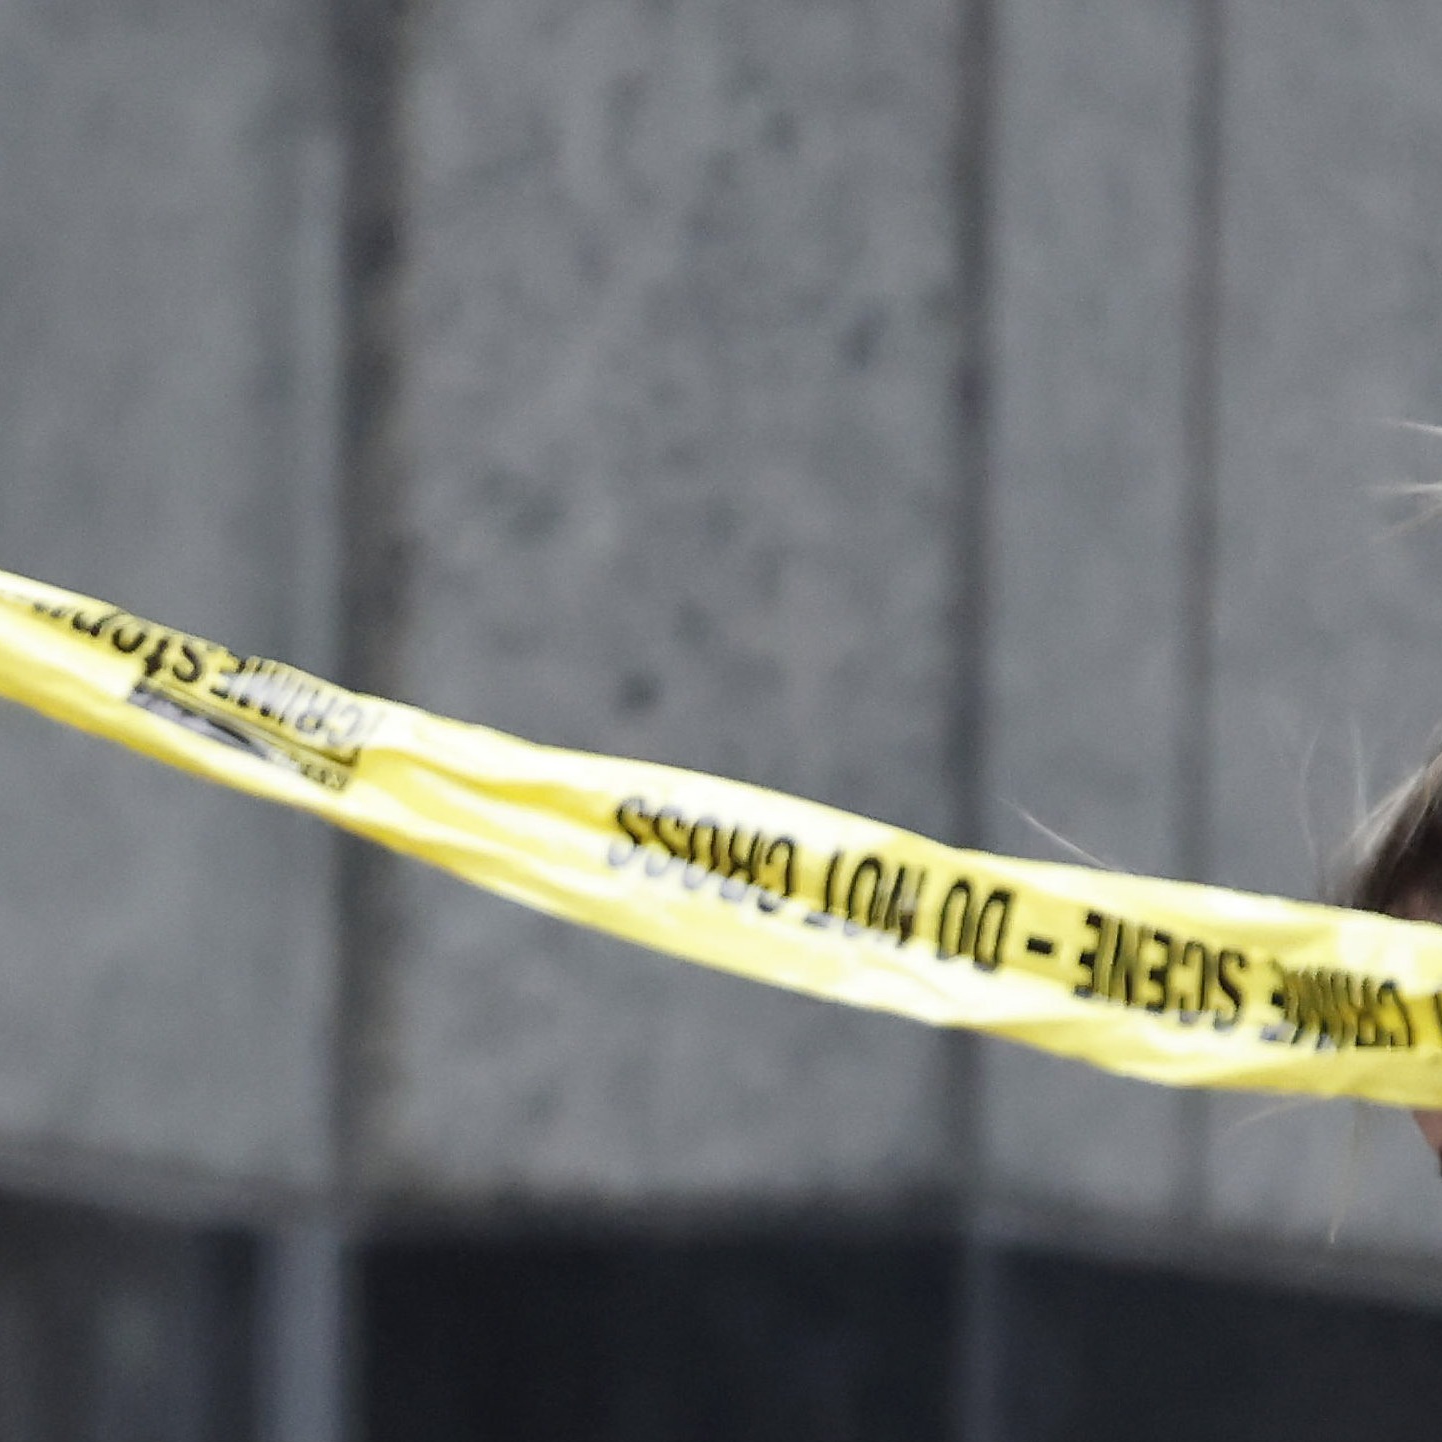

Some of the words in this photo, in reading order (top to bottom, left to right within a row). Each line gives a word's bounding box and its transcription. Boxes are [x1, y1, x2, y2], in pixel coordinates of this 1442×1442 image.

[608, 797, 797, 914] CROSS
[804, 849, 927, 948] NOT
[936, 879, 1017, 972] DO
[1072, 909, 1247, 1031] SCENE
[1261, 957, 1415, 1051] CRIME
